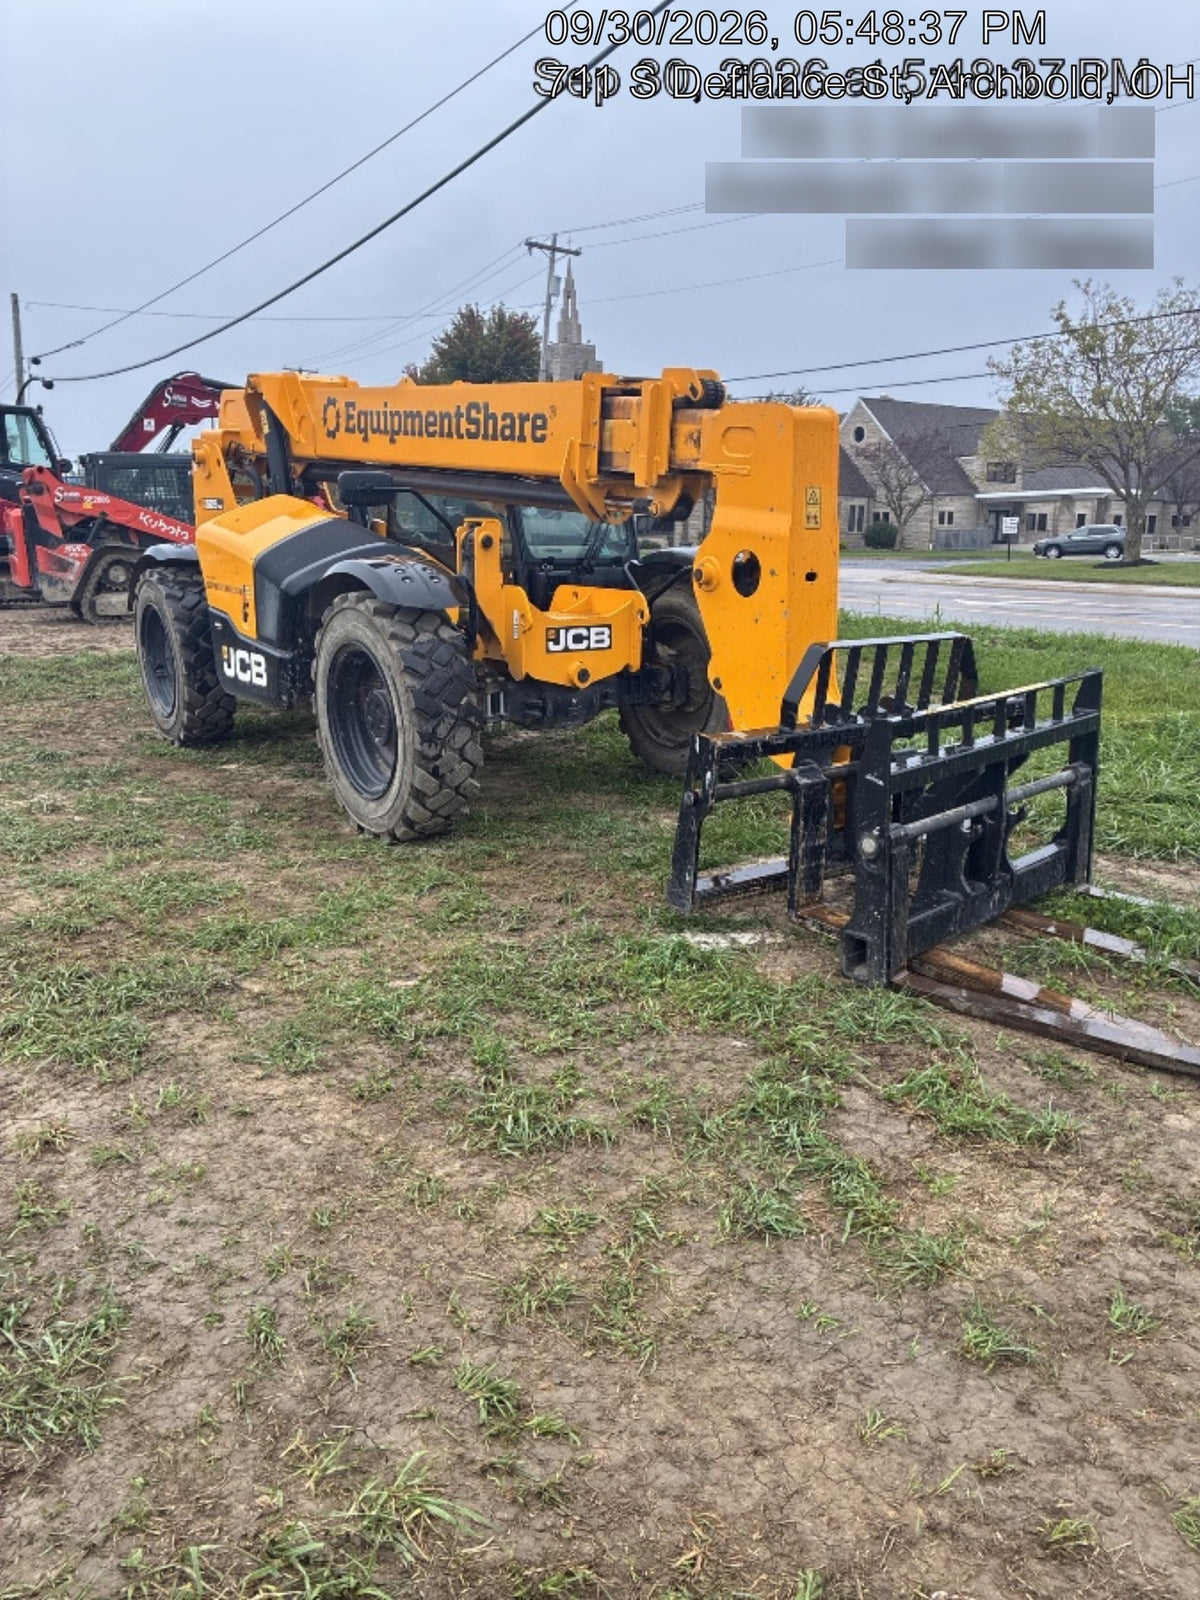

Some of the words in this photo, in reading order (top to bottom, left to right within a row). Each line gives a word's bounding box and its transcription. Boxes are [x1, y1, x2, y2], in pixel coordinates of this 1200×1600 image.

[344, 400, 549, 444] EquipmentShare
[139, 511, 189, 540] Kubota
[547, 626, 611, 652] JCB
[222, 645, 267, 687] JCB
